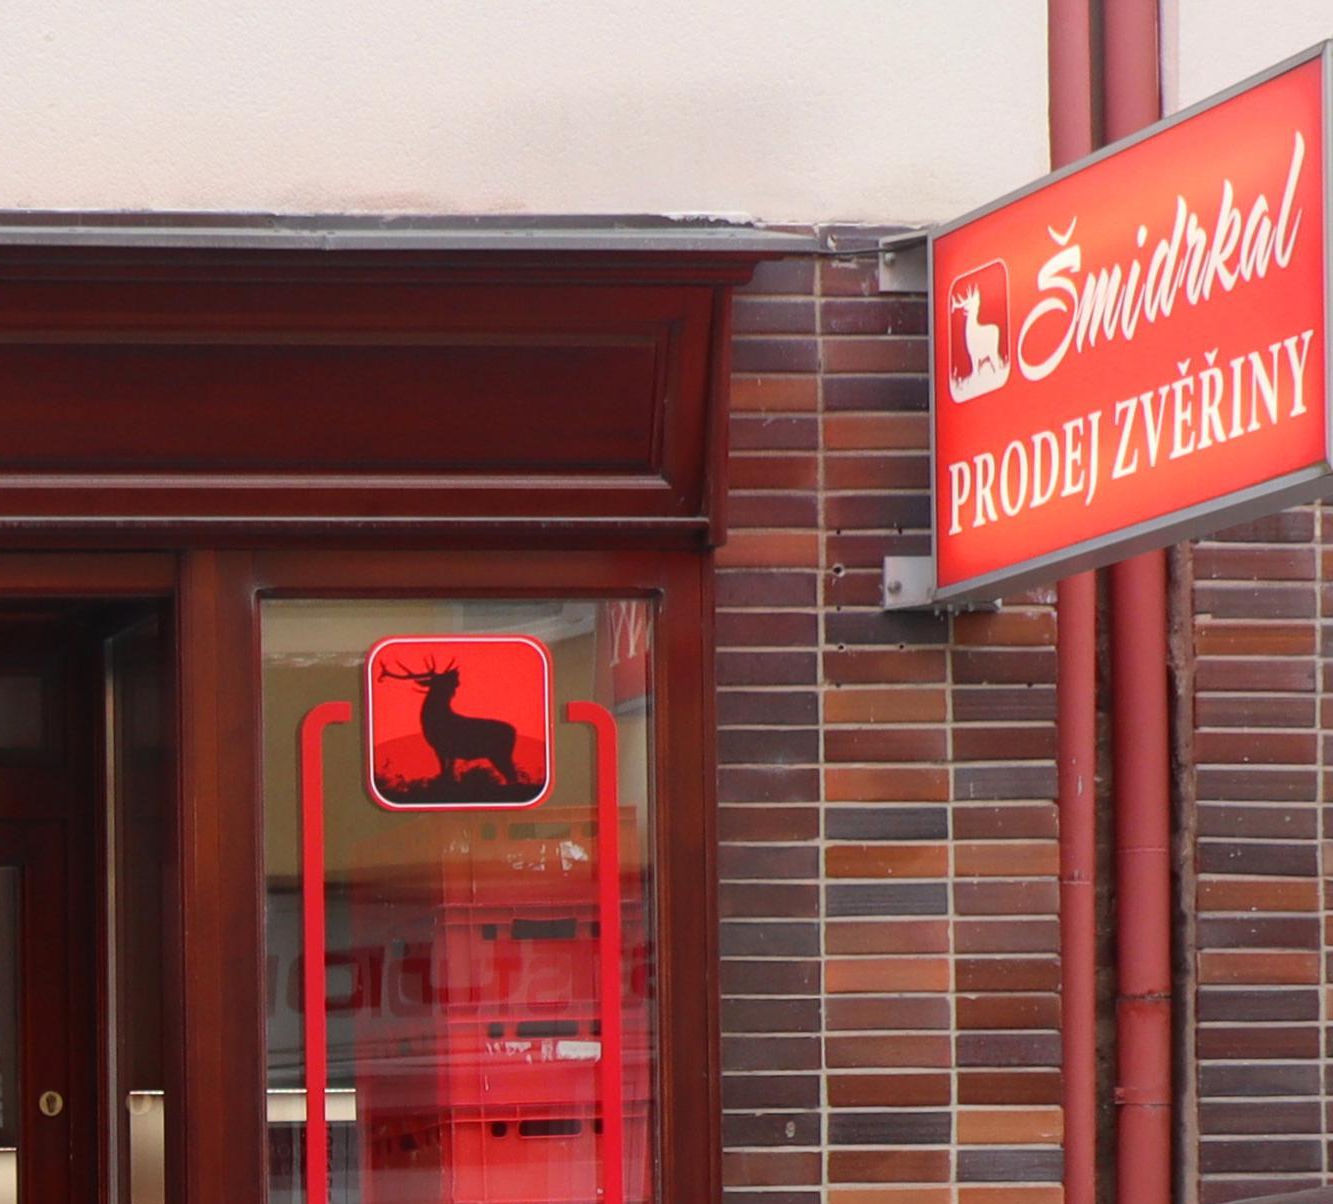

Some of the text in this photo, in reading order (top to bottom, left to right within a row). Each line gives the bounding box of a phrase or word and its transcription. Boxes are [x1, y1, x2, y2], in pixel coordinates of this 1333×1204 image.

[1017, 131, 1306, 381] Šmidrkal
[948, 330, 1315, 536] PRODEJ ZVĚŘINY
